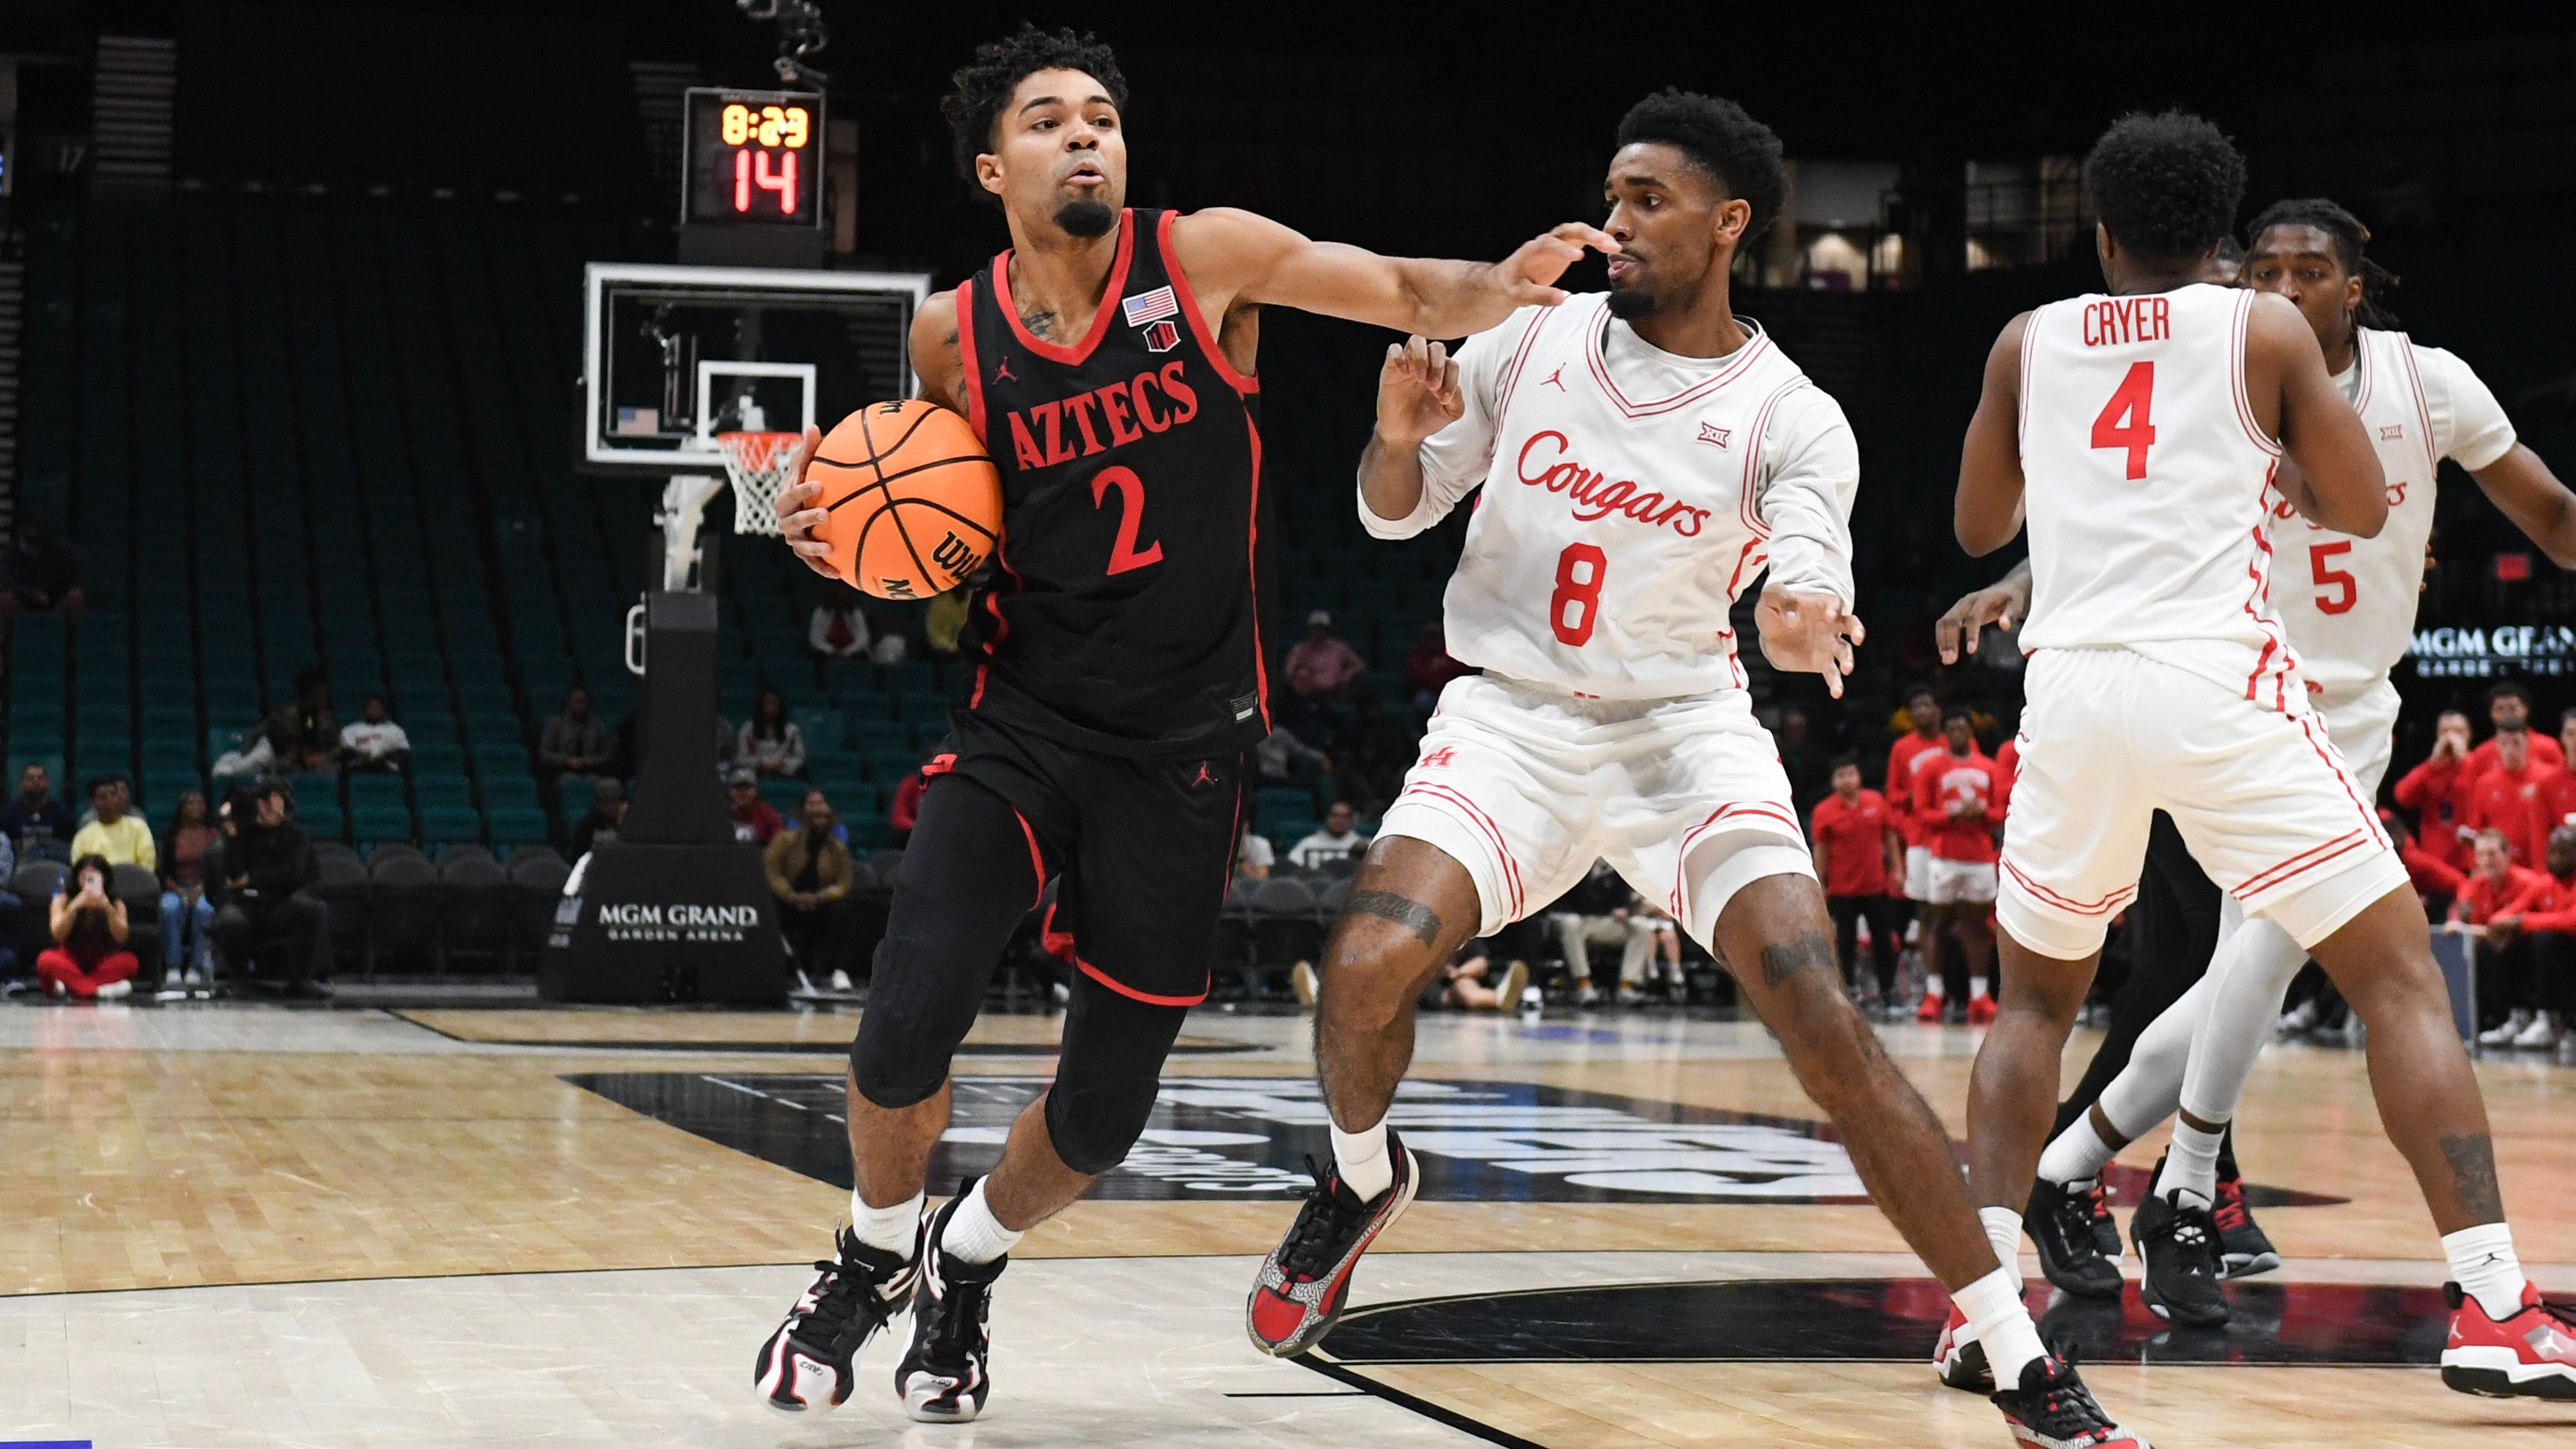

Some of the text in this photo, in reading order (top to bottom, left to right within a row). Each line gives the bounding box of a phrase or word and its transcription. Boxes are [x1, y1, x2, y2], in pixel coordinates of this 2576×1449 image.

[734, 148, 796, 214] 14
[2083, 297, 2170, 347] CRYER
[1007, 361, 1198, 471] AZTECS
[2090, 361, 2156, 481] 4
[1091, 465, 1164, 576] 2
[1518, 430, 1711, 537] Cougars
[1550, 542, 1607, 647] 8
[2308, 540, 2357, 616] 5
[2406, 627, 2486, 656] MGM
[599, 903, 758, 927] MGM GRAND
[608, 928, 744, 942] GARDEN ARENA
